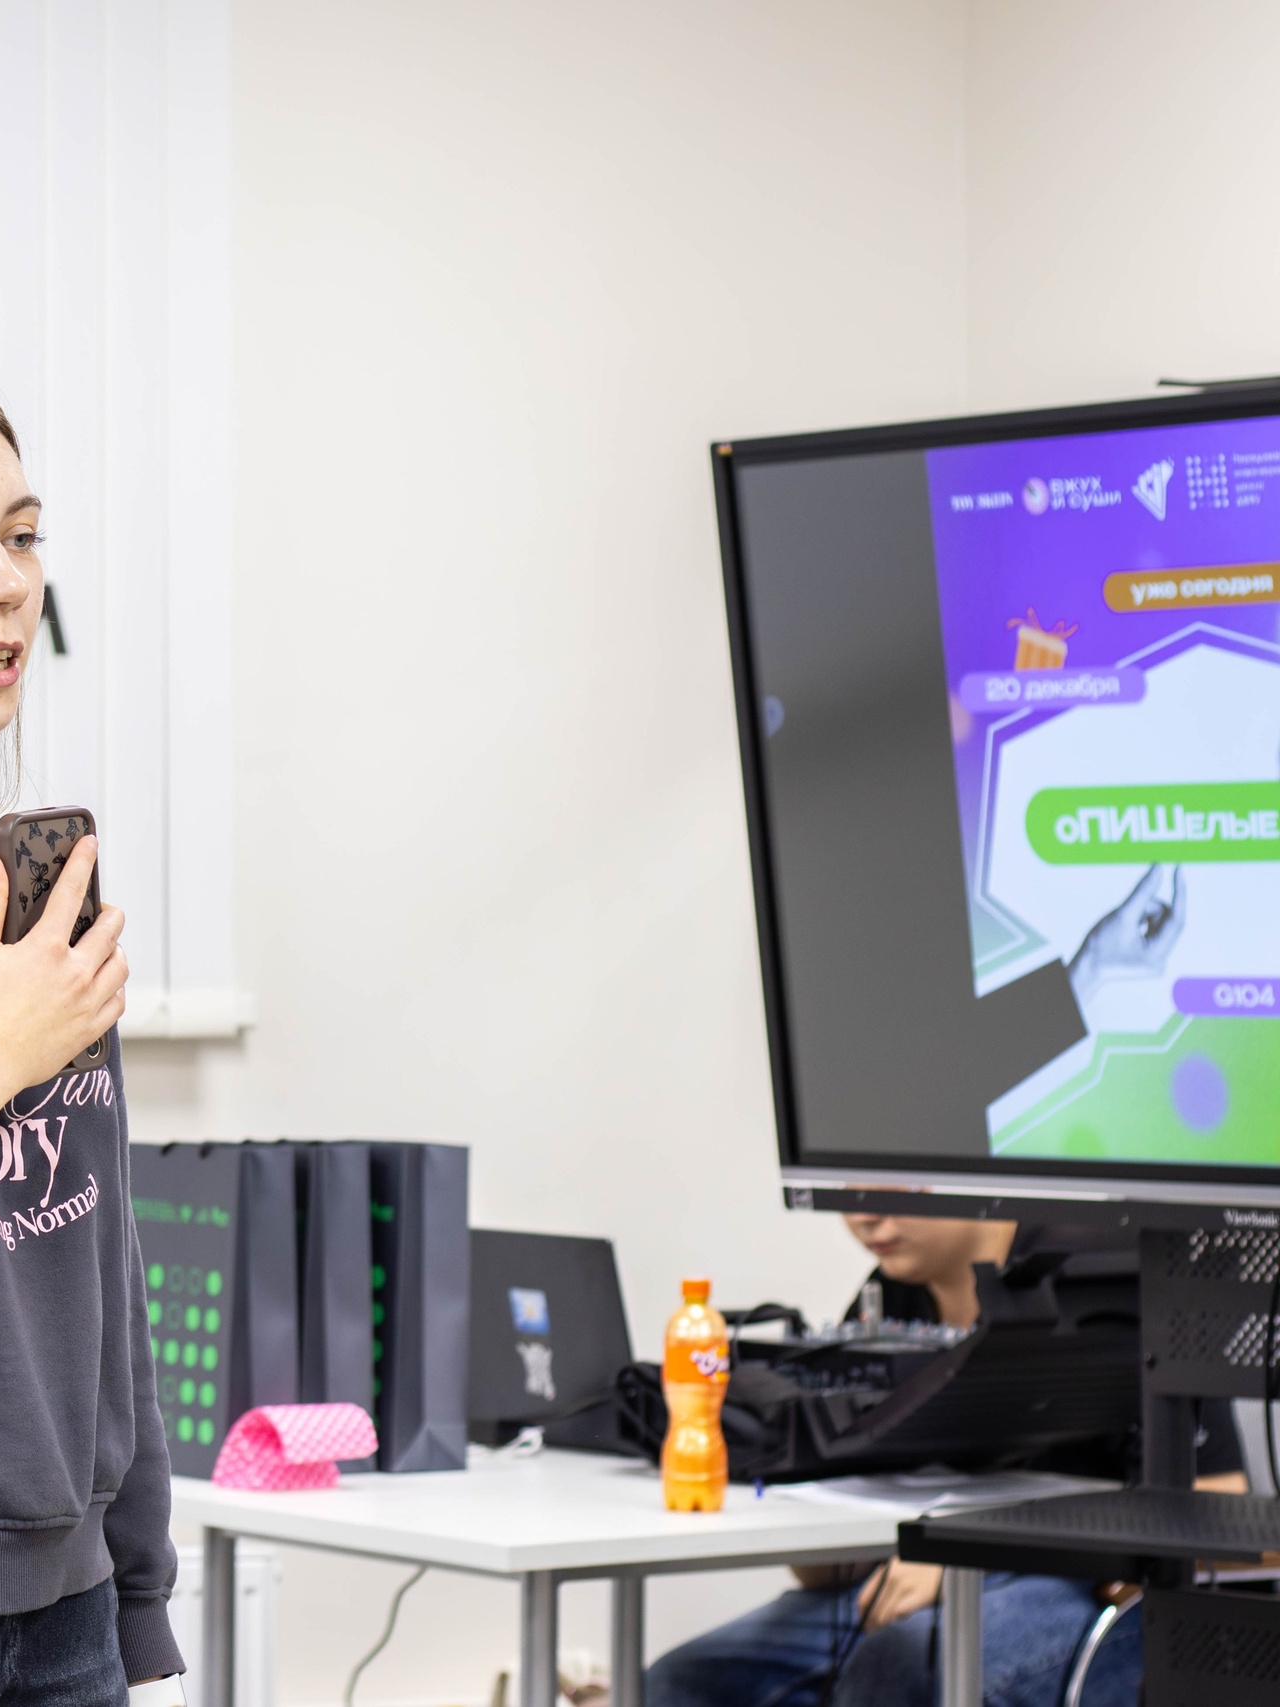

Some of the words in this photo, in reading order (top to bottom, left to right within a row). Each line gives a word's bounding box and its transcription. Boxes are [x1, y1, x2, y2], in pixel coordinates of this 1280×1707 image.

[1130, 580, 1177, 606] уже
[1180, 574, 1273, 598] сегодня
[985, 676, 1020, 701] 20
[1024, 673, 1120, 700] декабря
[12, 1173, 99, 1240] Normal
